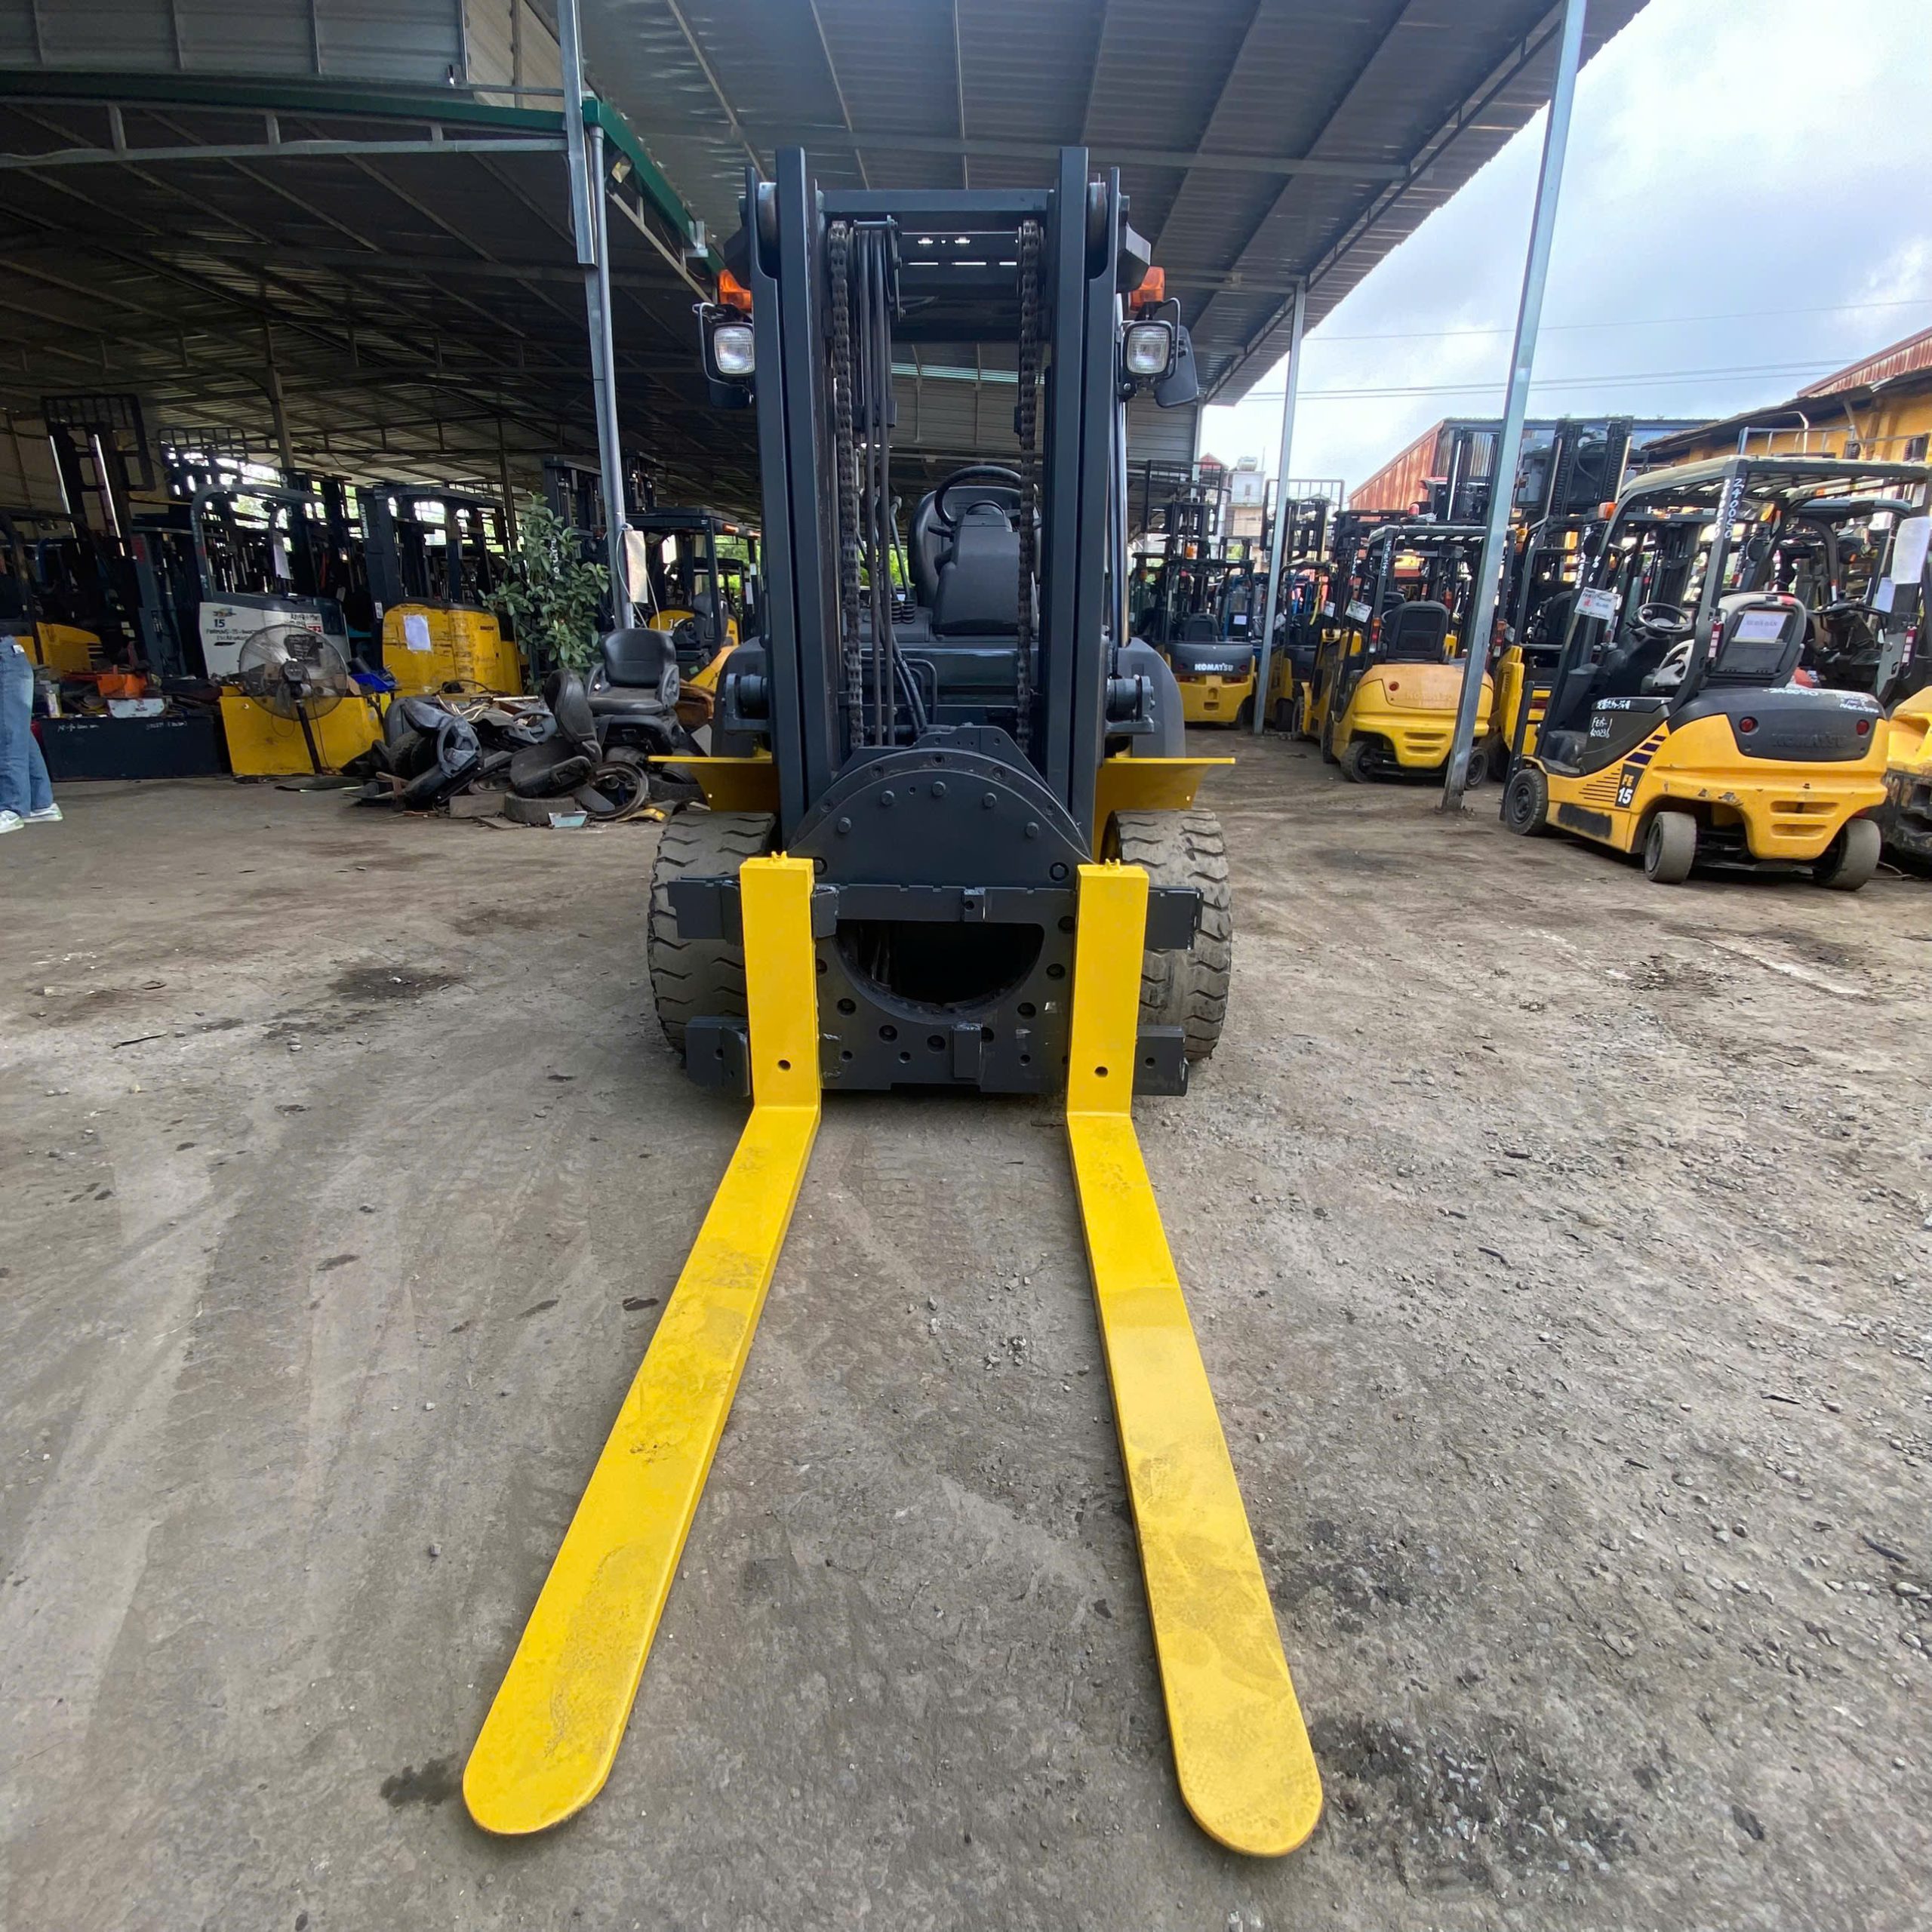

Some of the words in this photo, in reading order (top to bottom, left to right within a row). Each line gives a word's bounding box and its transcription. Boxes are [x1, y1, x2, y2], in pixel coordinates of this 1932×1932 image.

[1724, 478, 1745, 539] 240050
[214, 619, 225, 628] 15
[1195, 663, 1233, 672] KOMATSU
[1622, 774, 1635, 787] FE
[1617, 787, 1634, 804] 15
